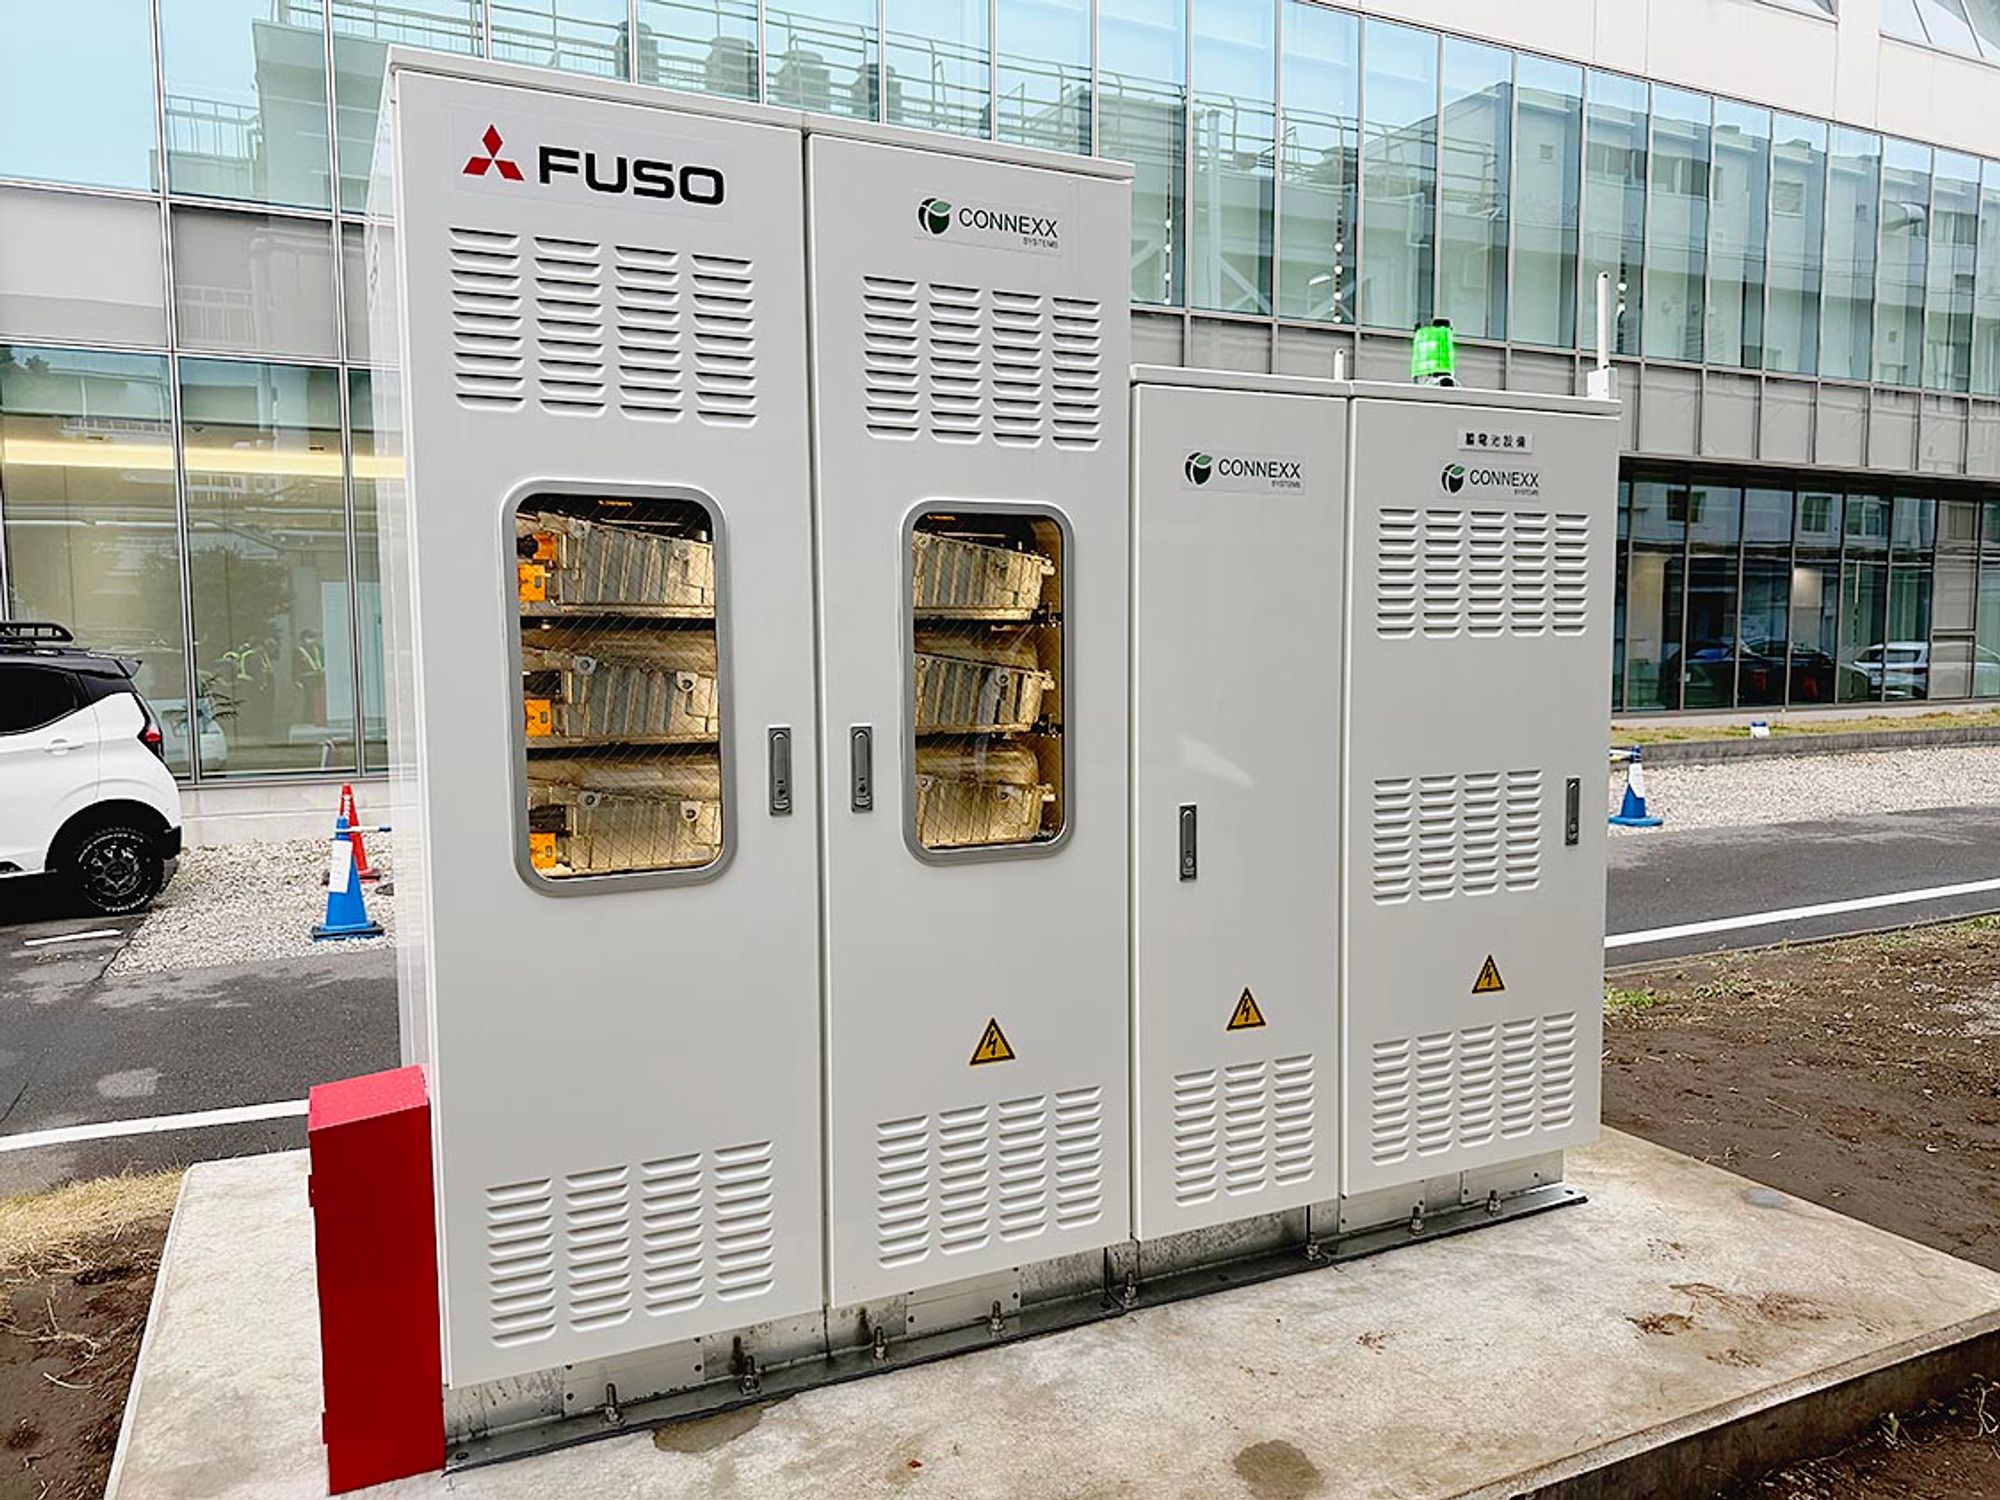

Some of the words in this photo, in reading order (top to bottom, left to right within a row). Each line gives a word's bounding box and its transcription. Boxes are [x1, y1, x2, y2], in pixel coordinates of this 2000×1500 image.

[538, 145, 725, 206] FUSO
[958, 207, 1058, 239] CONNEXX
[1218, 458, 1301, 479] CONNEXX
[1469, 469, 1539, 488] CONNEXX
